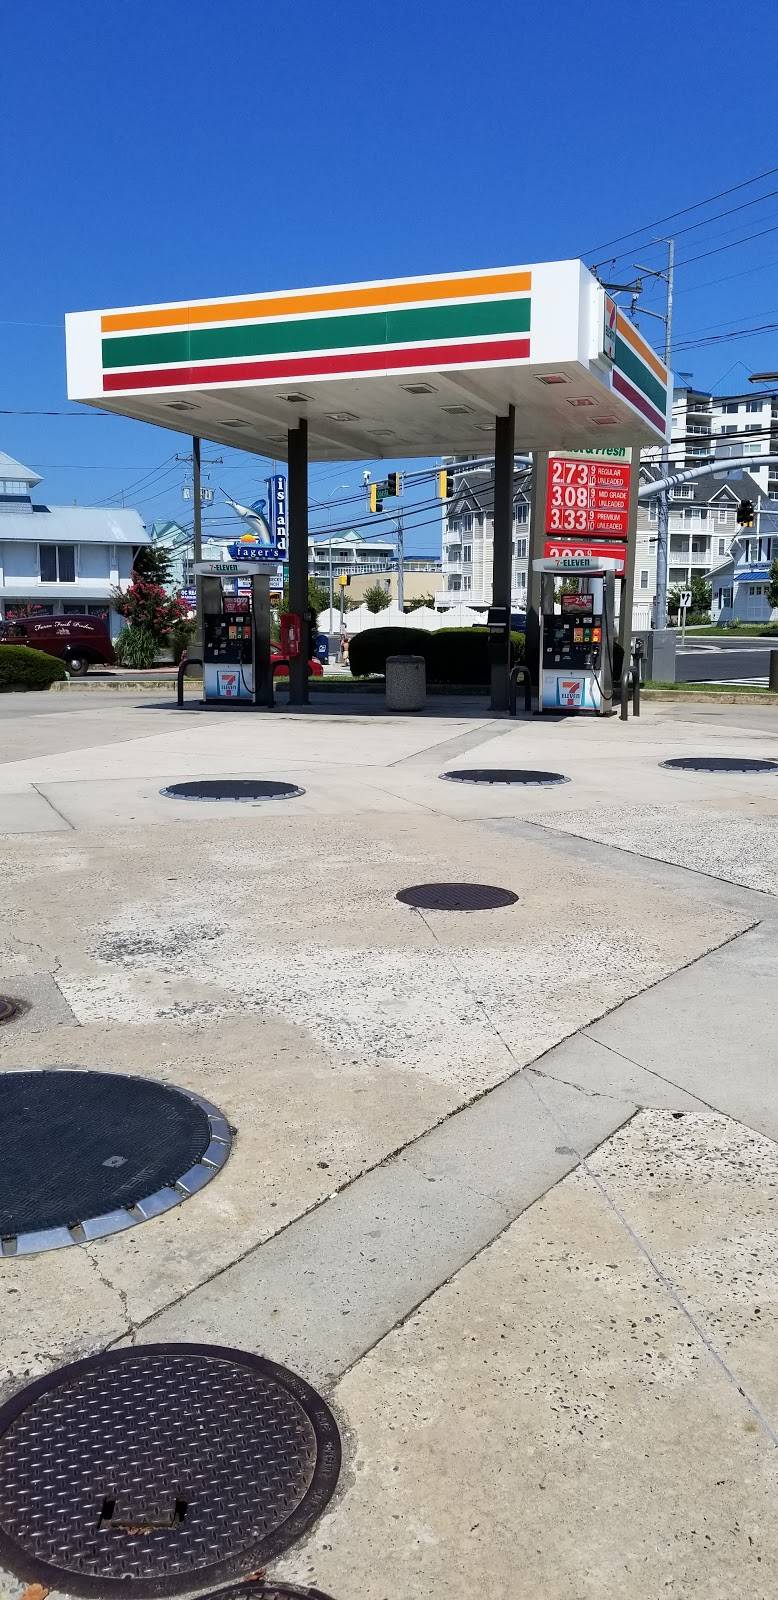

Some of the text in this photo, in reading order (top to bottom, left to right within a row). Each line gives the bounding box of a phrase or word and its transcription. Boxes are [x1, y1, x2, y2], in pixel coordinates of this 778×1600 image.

[552, 462, 588, 484] 2.73
[551, 486, 588, 507] 3.08
[276, 477, 286, 550] island
[550, 509, 587, 530] 3.33
[237, 548, 279, 557] fager's
